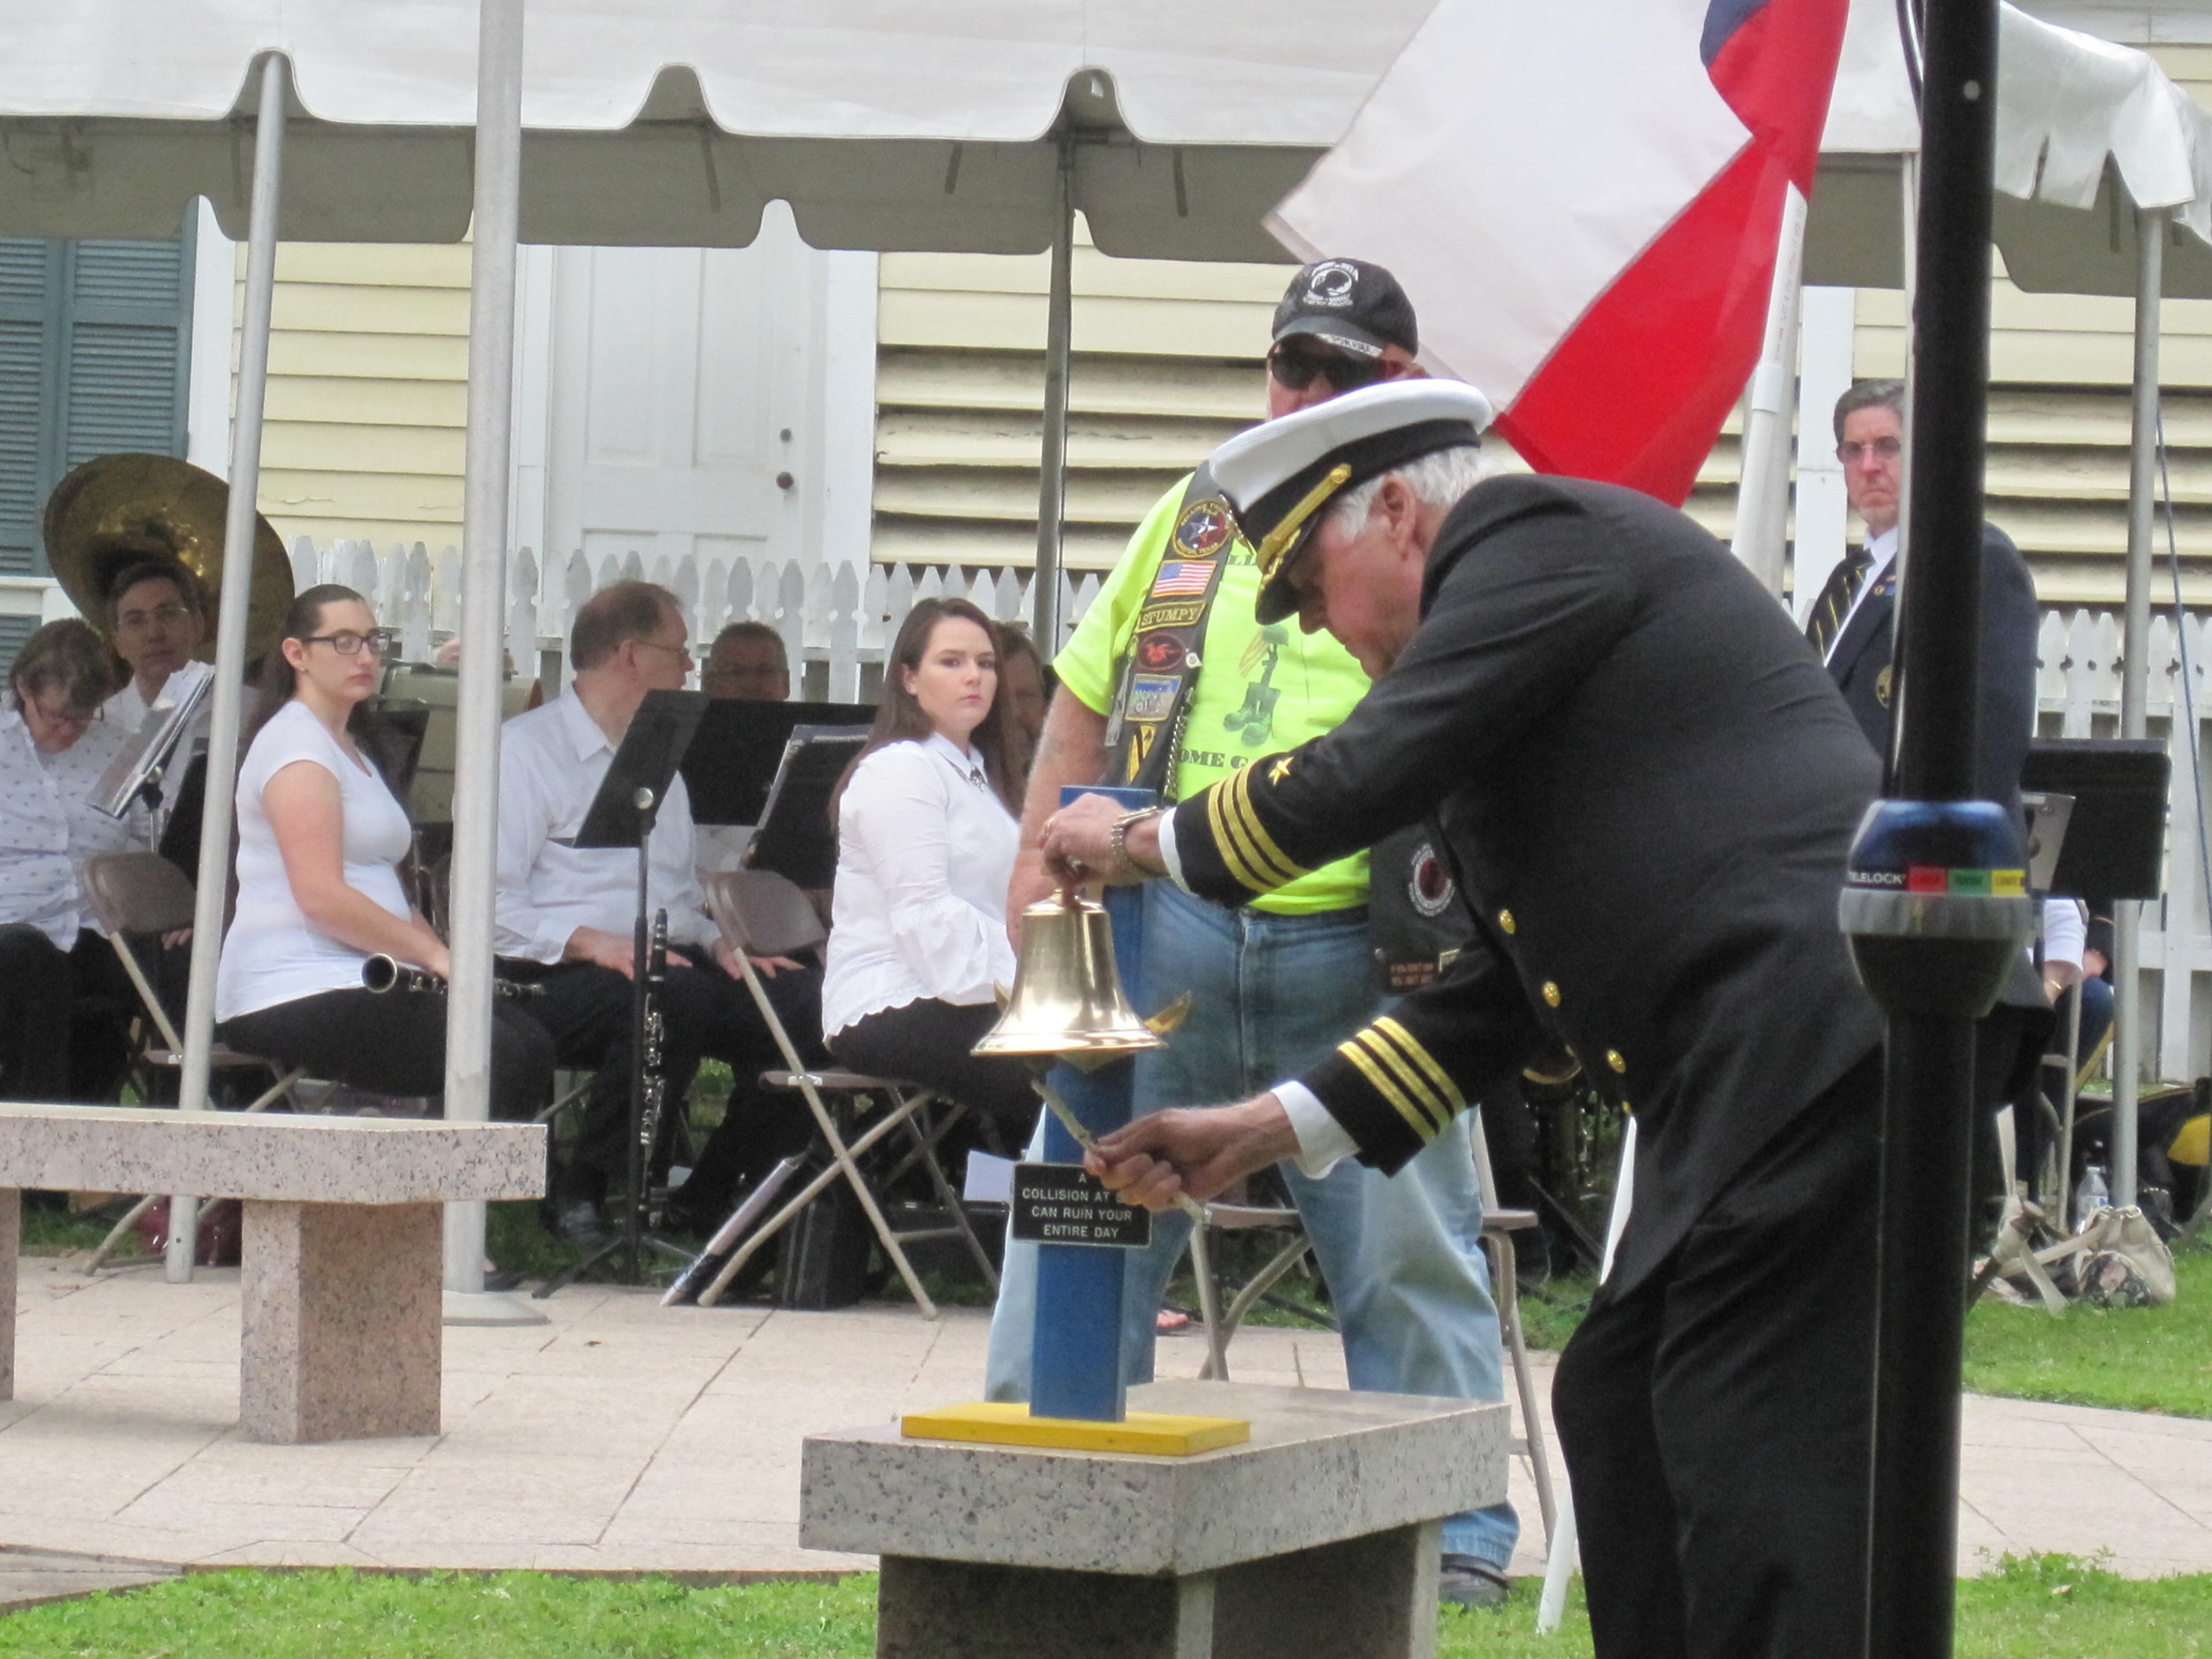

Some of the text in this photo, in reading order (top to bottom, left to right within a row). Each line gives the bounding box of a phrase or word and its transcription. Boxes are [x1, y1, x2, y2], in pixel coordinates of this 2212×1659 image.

[1141, 609, 1197, 625] STUMPY
[1179, 749, 1225, 767] OME
[1079, 1173, 1087, 1184] A
[1022, 1188, 1110, 1202] COLLISION AT
[1032, 1206, 1133, 1221] CAN RUIN YOUR
[1043, 1225, 1119, 1239] ENTIRE DAY
